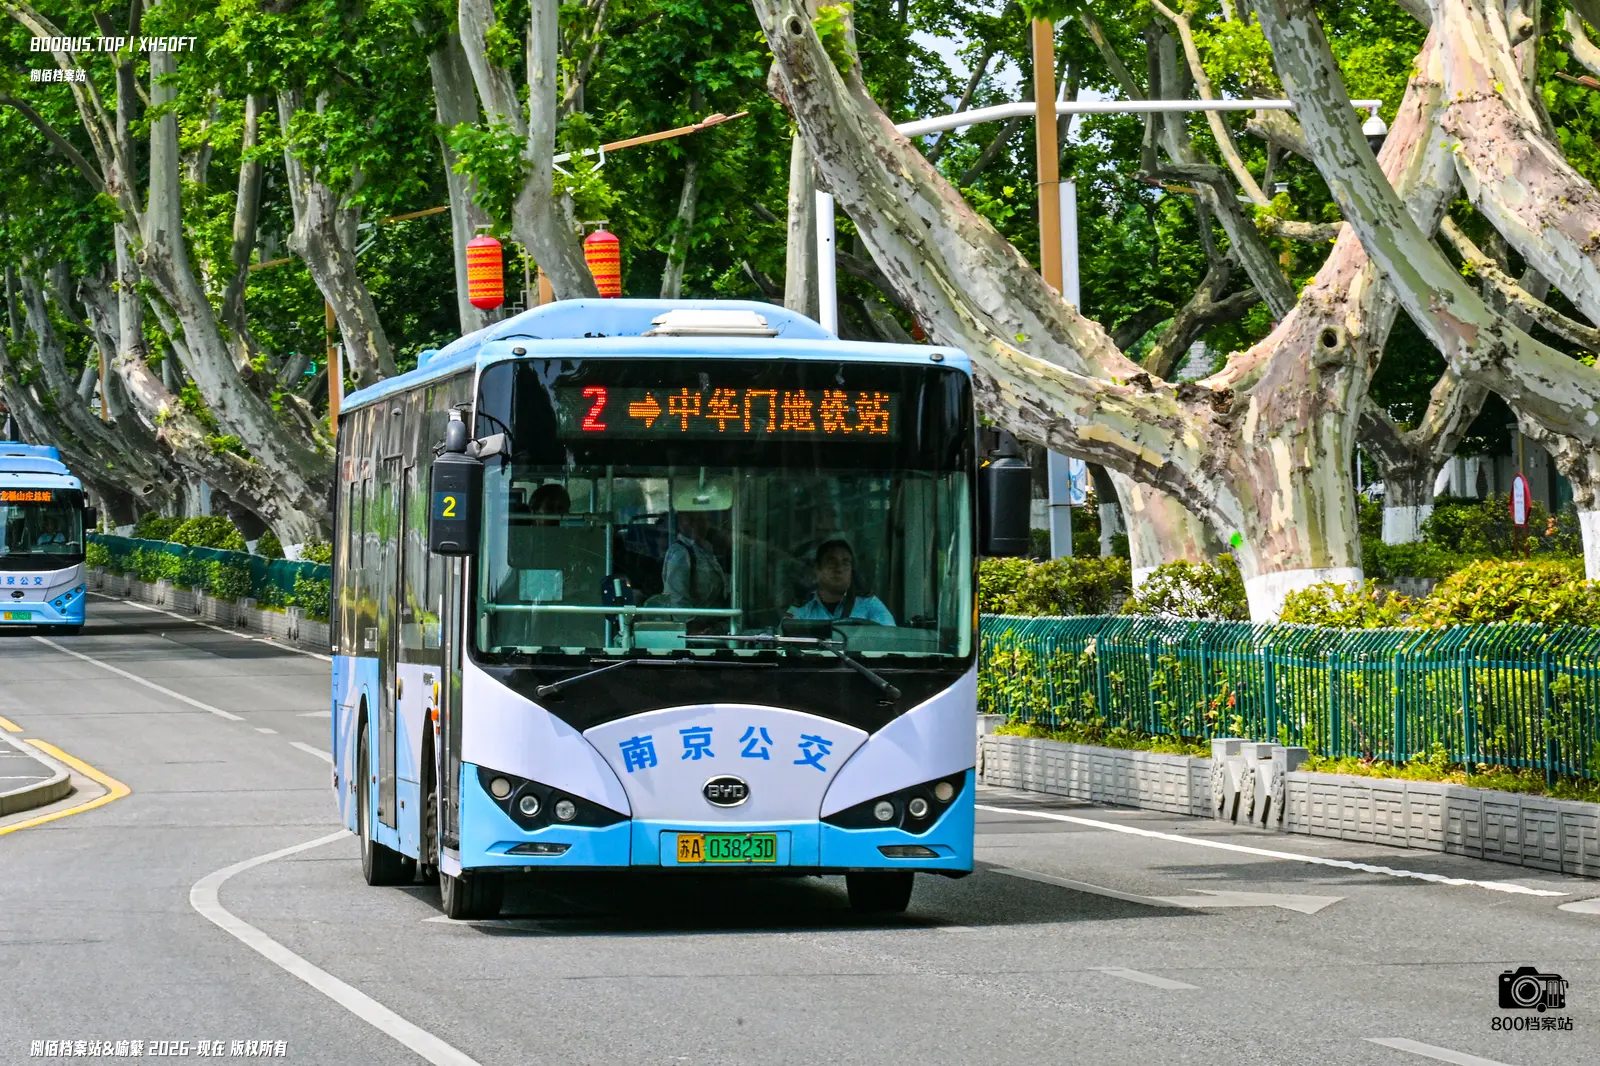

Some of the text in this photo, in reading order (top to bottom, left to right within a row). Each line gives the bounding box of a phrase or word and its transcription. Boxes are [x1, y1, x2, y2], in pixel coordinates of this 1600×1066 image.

[583, 387, 890, 434] 2 中华门地铁站
[442, 496, 457, 517] 2
[0, 576, 43, 586] 京公交
[618, 726, 834, 773] 南京公交
[707, 784, 745, 799] BYD
